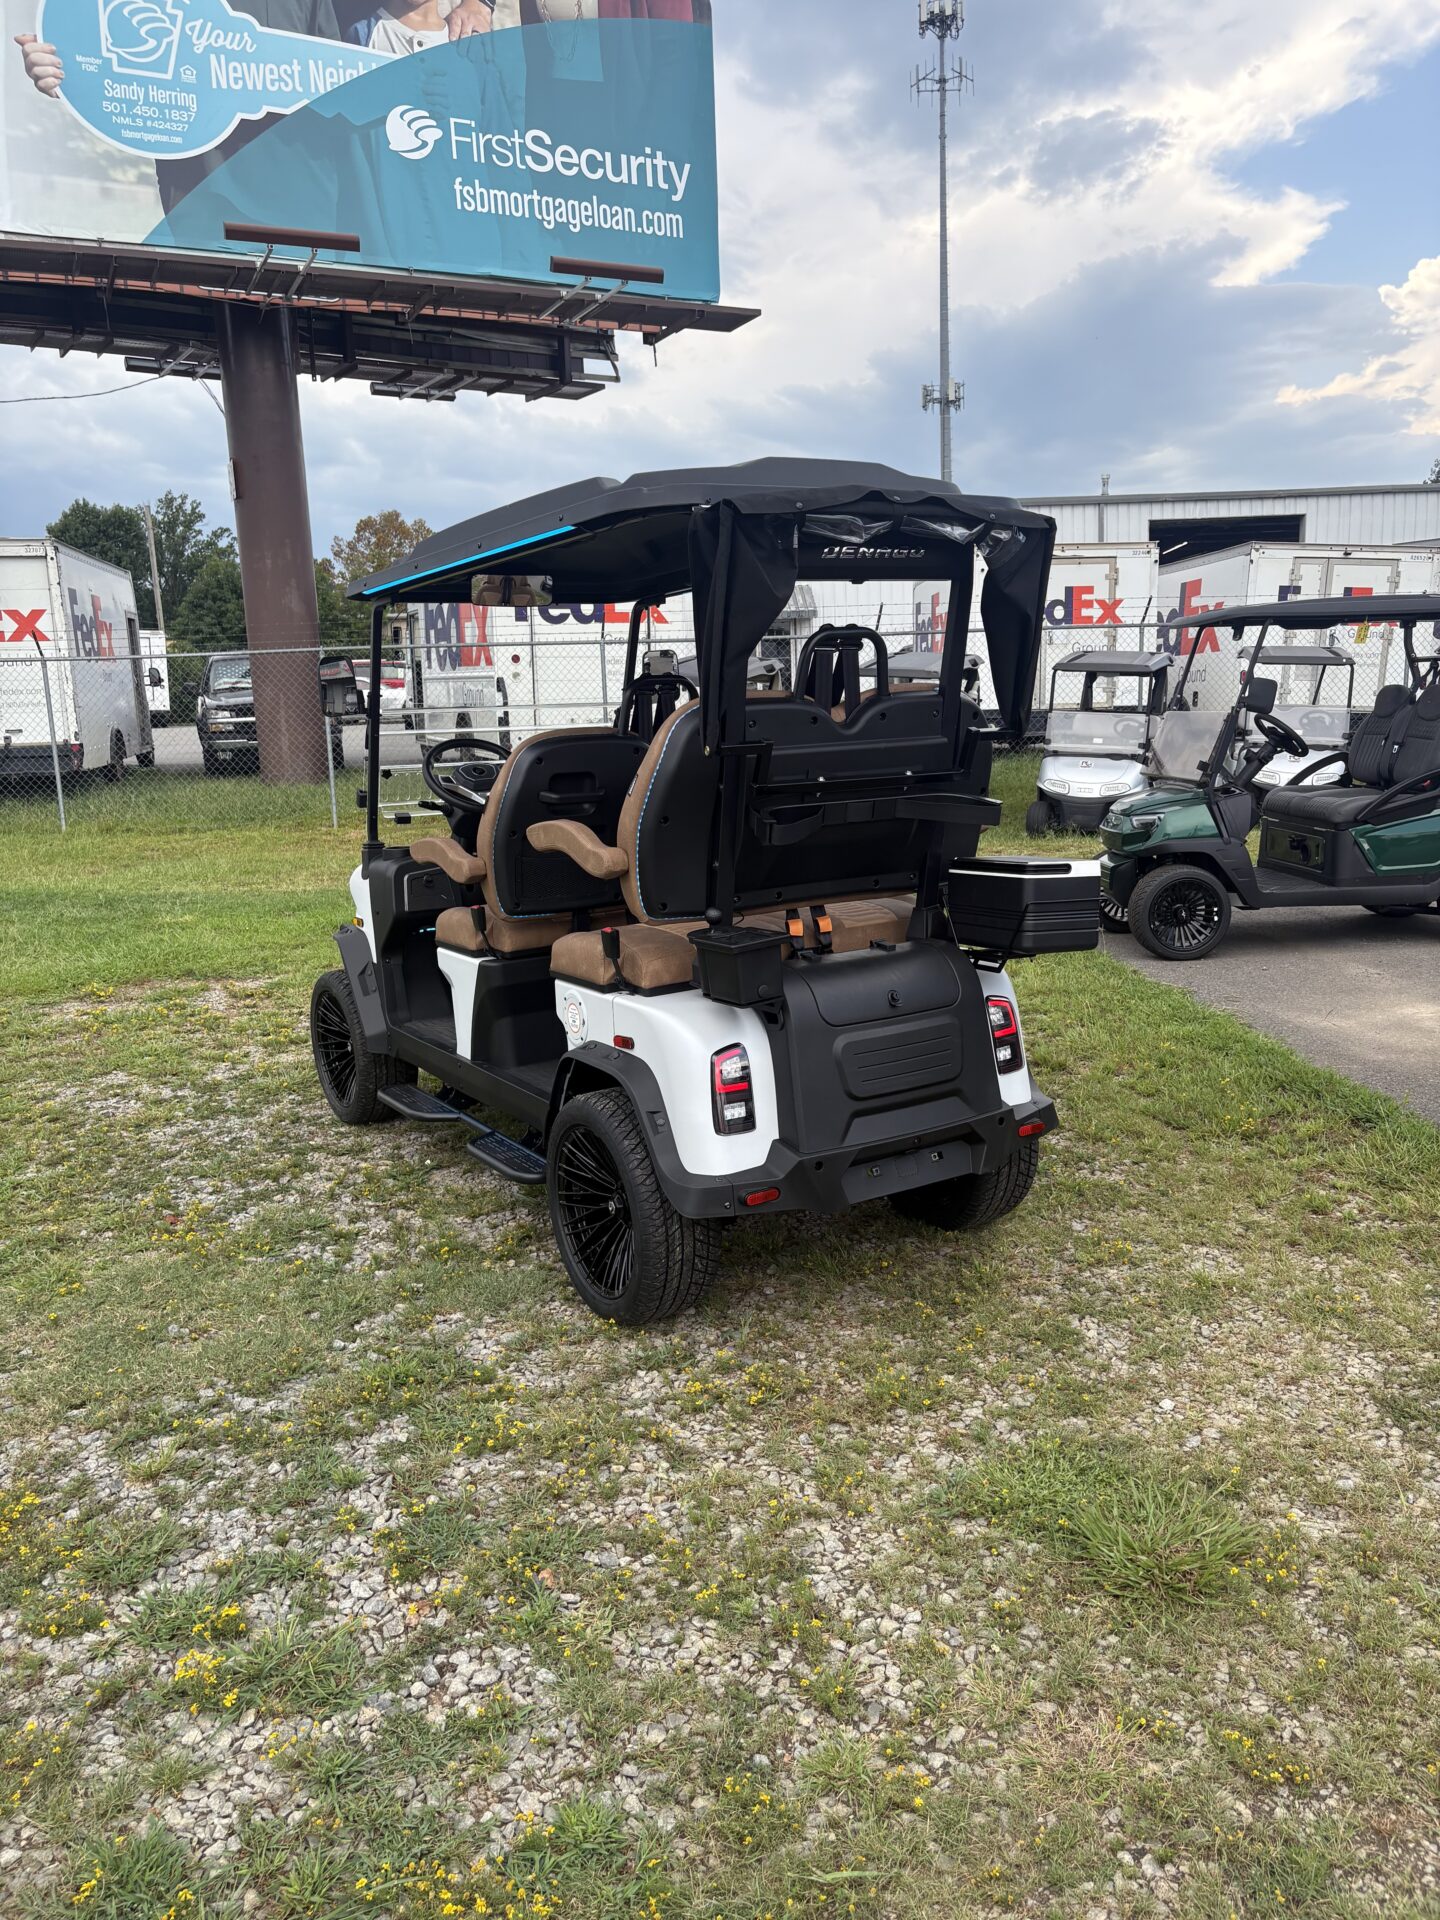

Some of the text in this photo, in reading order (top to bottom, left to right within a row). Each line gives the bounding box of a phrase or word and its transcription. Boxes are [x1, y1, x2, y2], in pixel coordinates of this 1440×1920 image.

[185, 19, 257, 54] Your
[75, 54, 103, 65] Member
[81, 63, 99, 73] FDIC
[209, 53, 303, 93] Newest
[102, 100, 196, 122] 501.450.1837
[104, 78, 198, 112] Sandy Herring
[112, 115, 189, 132] NMLS #424327
[449, 117, 691, 202] FirstSecurity
[453, 176, 684, 239] fsbmortgageloan.com
[67, 587, 117, 663] FedEx
[1347, 628, 1386, 639] Gund
